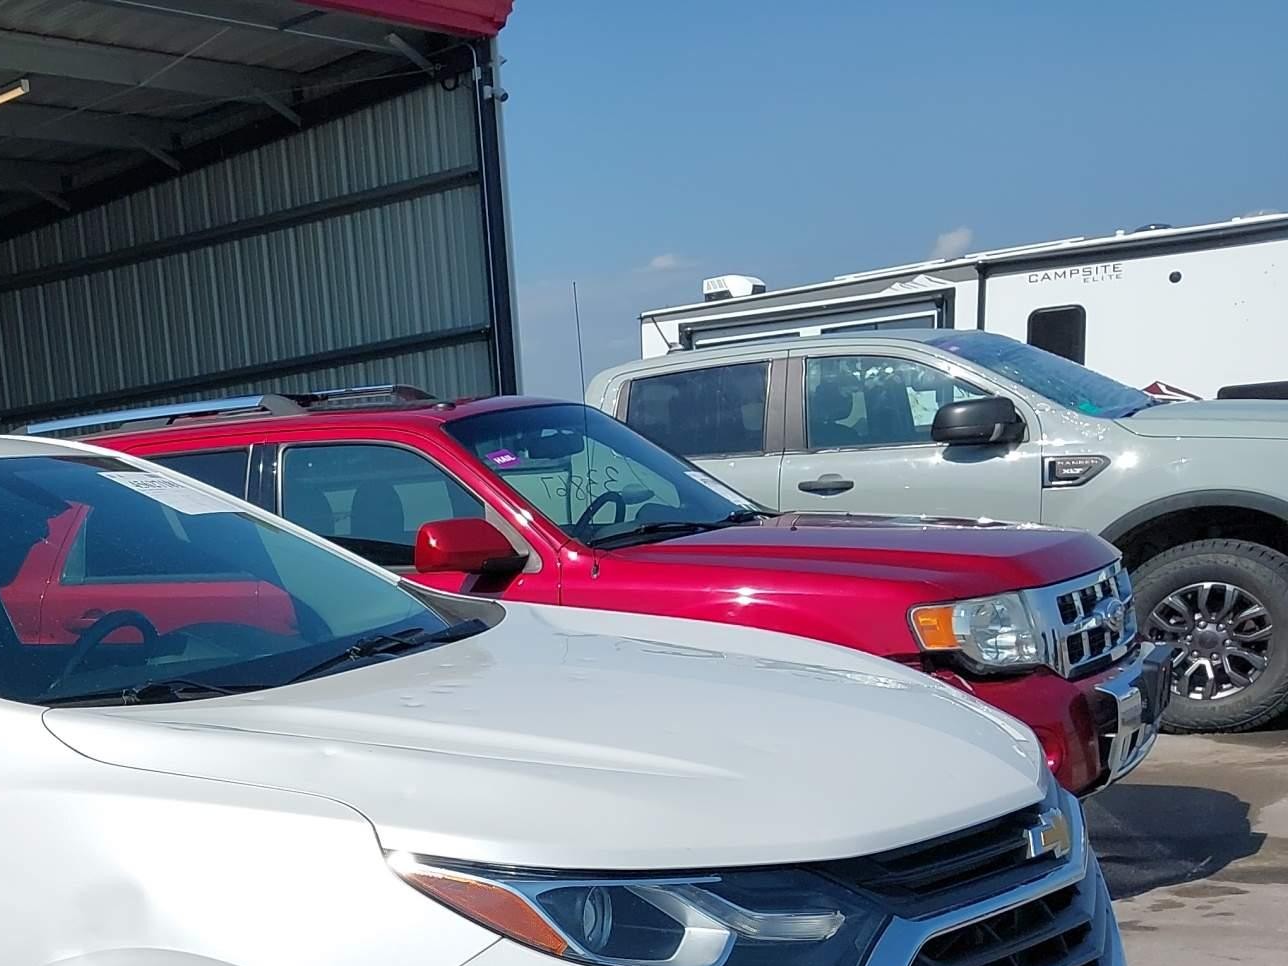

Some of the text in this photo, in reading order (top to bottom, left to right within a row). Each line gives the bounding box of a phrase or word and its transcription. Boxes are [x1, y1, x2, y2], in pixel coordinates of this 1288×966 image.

[1028, 263, 1123, 283] CAMPSITE
[1083, 273, 1123, 283] ELITE
[493, 454, 517, 465] HAIL
